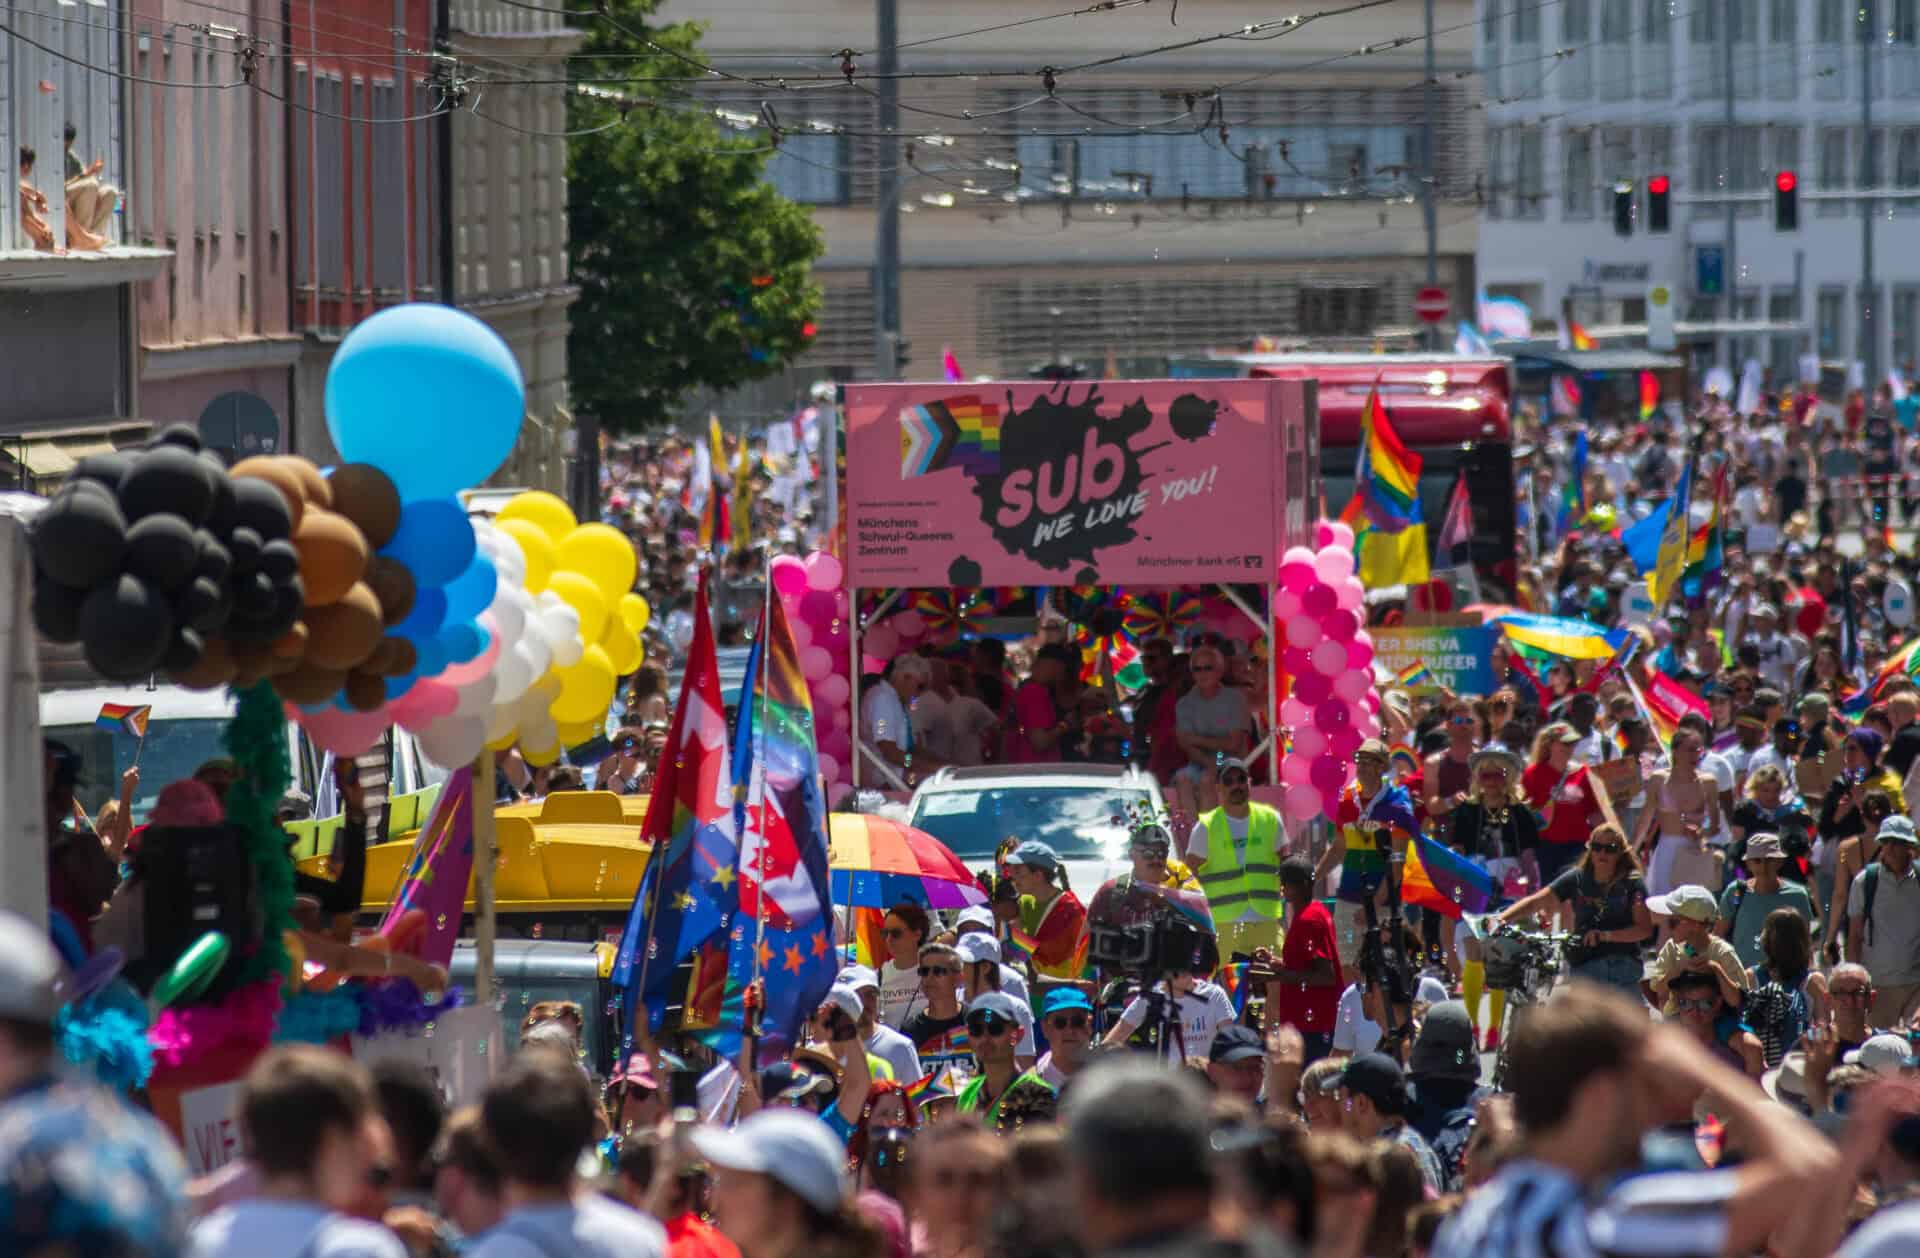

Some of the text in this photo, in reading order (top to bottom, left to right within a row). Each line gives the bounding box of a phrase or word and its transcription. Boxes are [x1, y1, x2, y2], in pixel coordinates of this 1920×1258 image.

[1032, 465, 1219, 548] WE LOVE YOU!
[857, 517, 918, 529] Münchens
[858, 544, 908, 556] Zentrum
